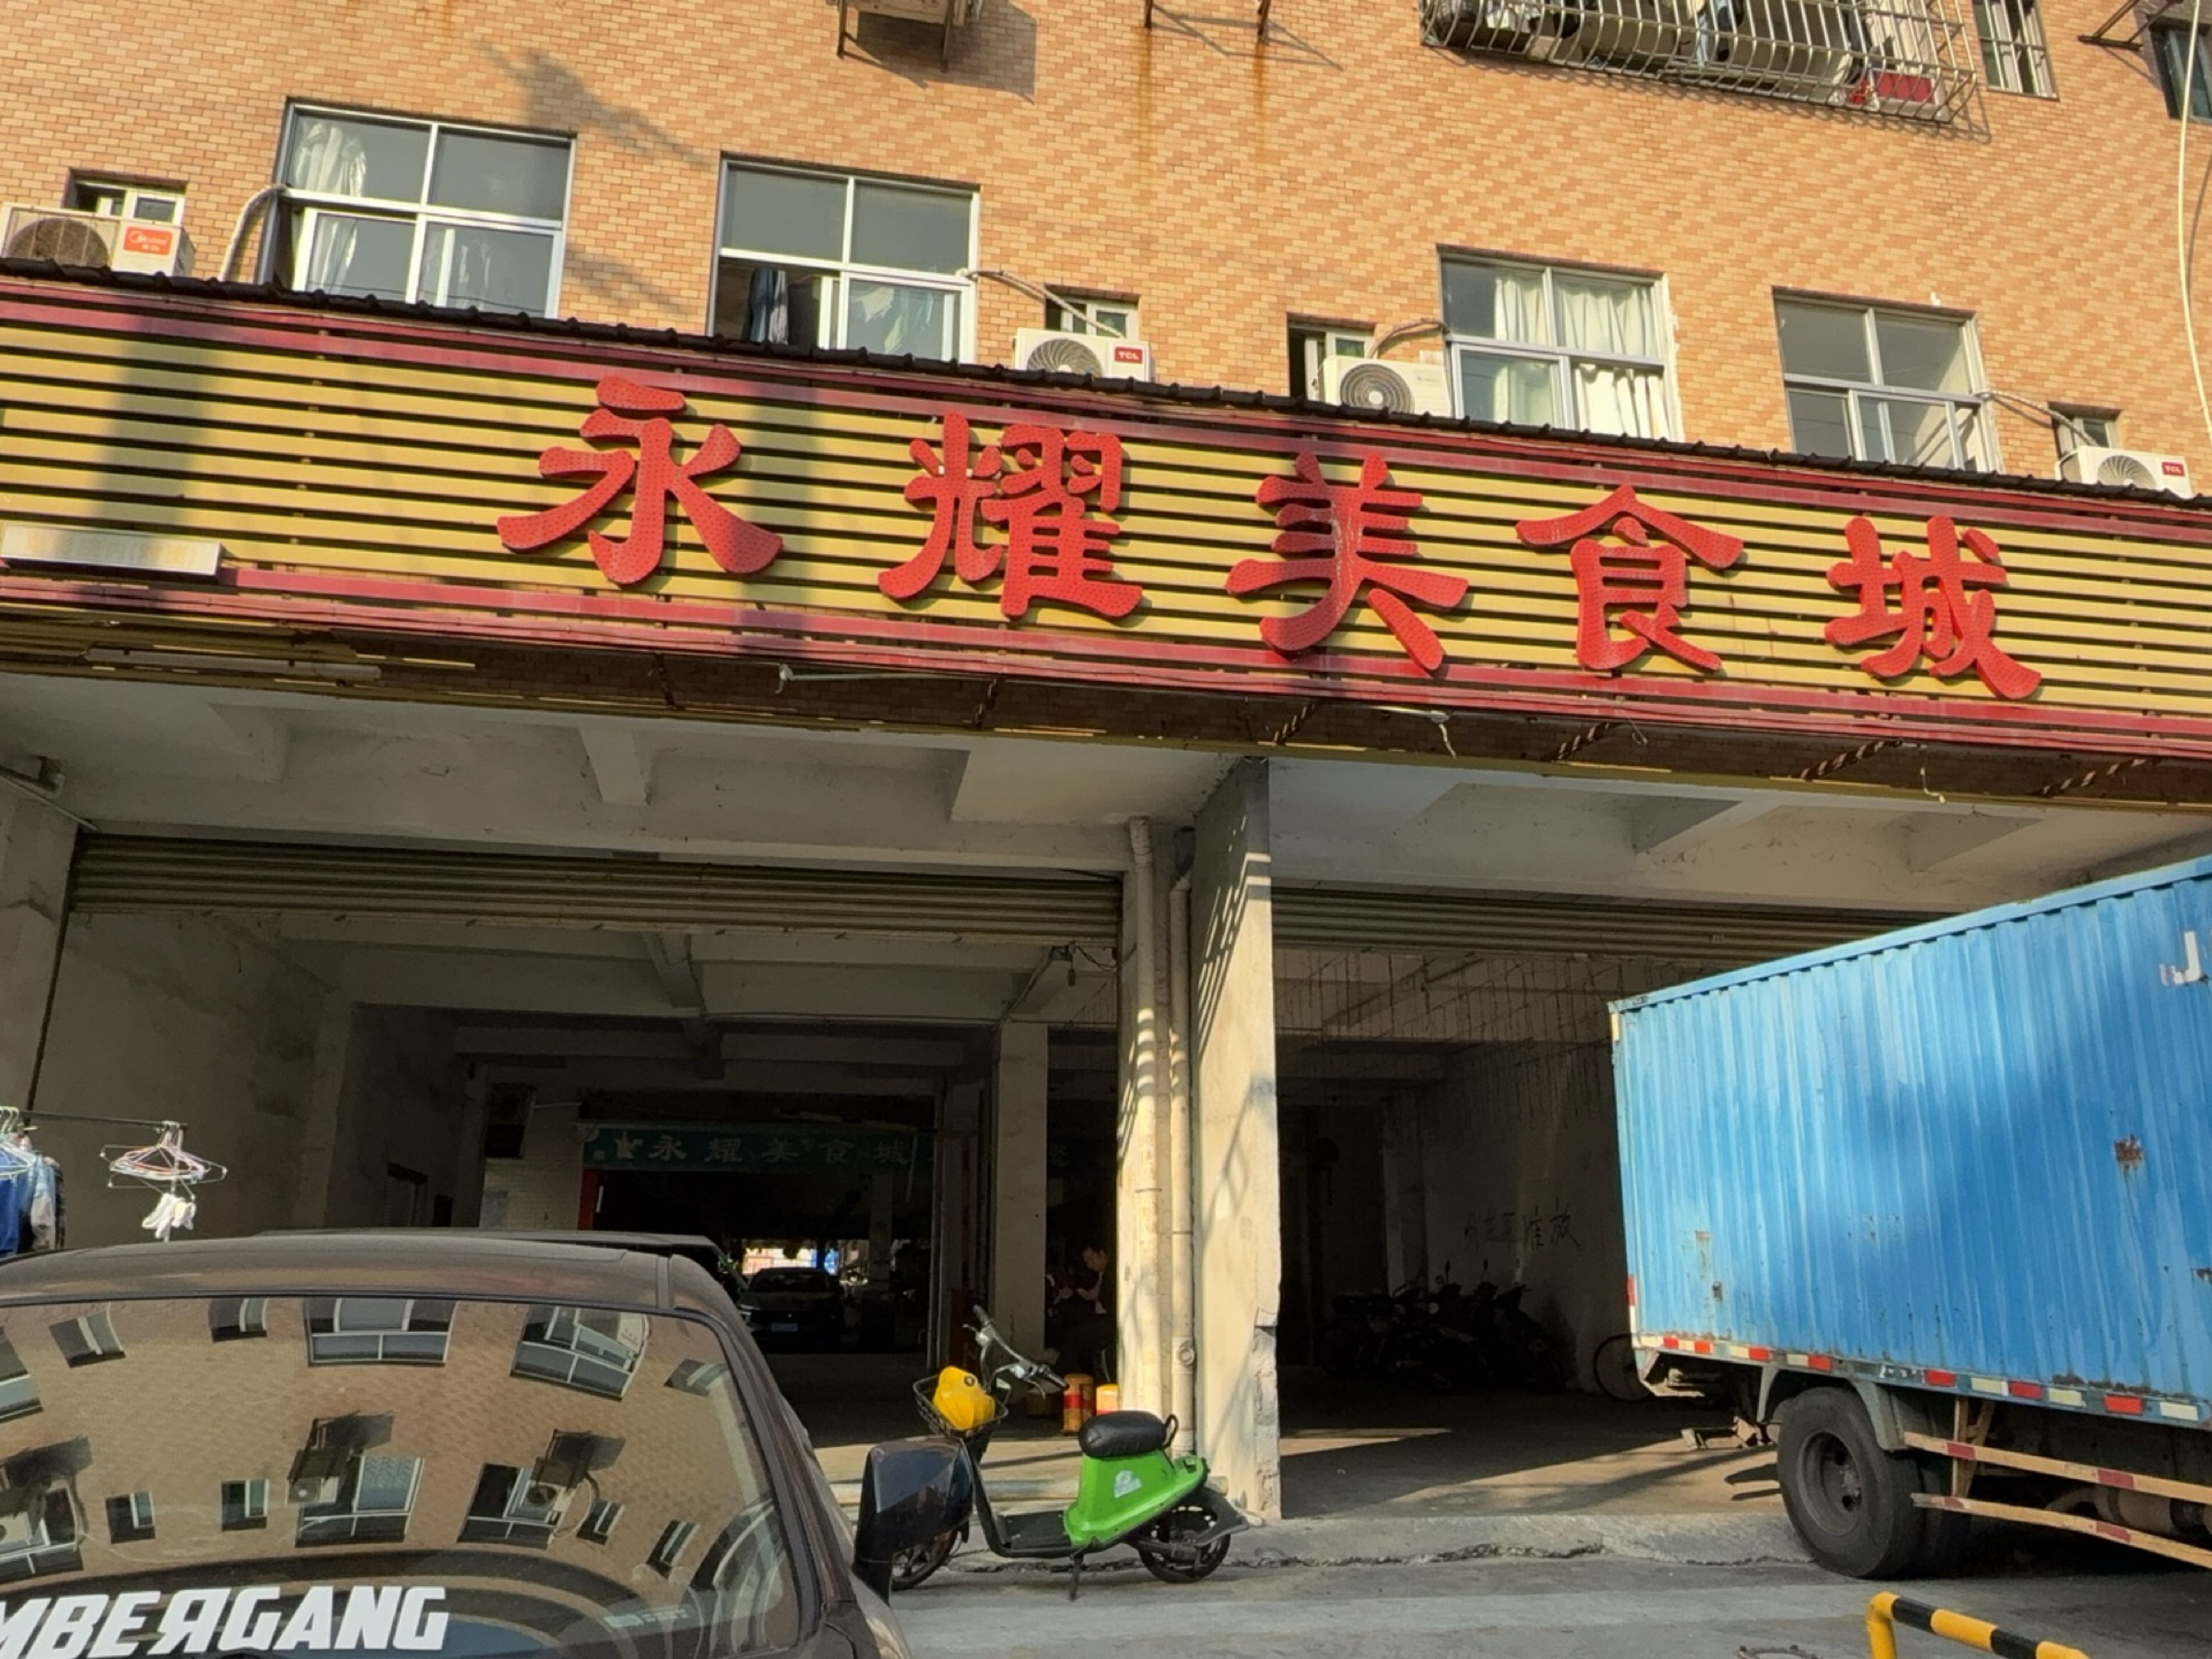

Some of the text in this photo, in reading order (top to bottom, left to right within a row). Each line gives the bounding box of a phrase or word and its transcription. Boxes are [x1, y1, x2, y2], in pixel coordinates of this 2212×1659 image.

[1118, 351, 1139, 360] TCL
[497, 376, 2041, 700] 永耀美食城
[648, 1135, 910, 1166] 永耀美食城
